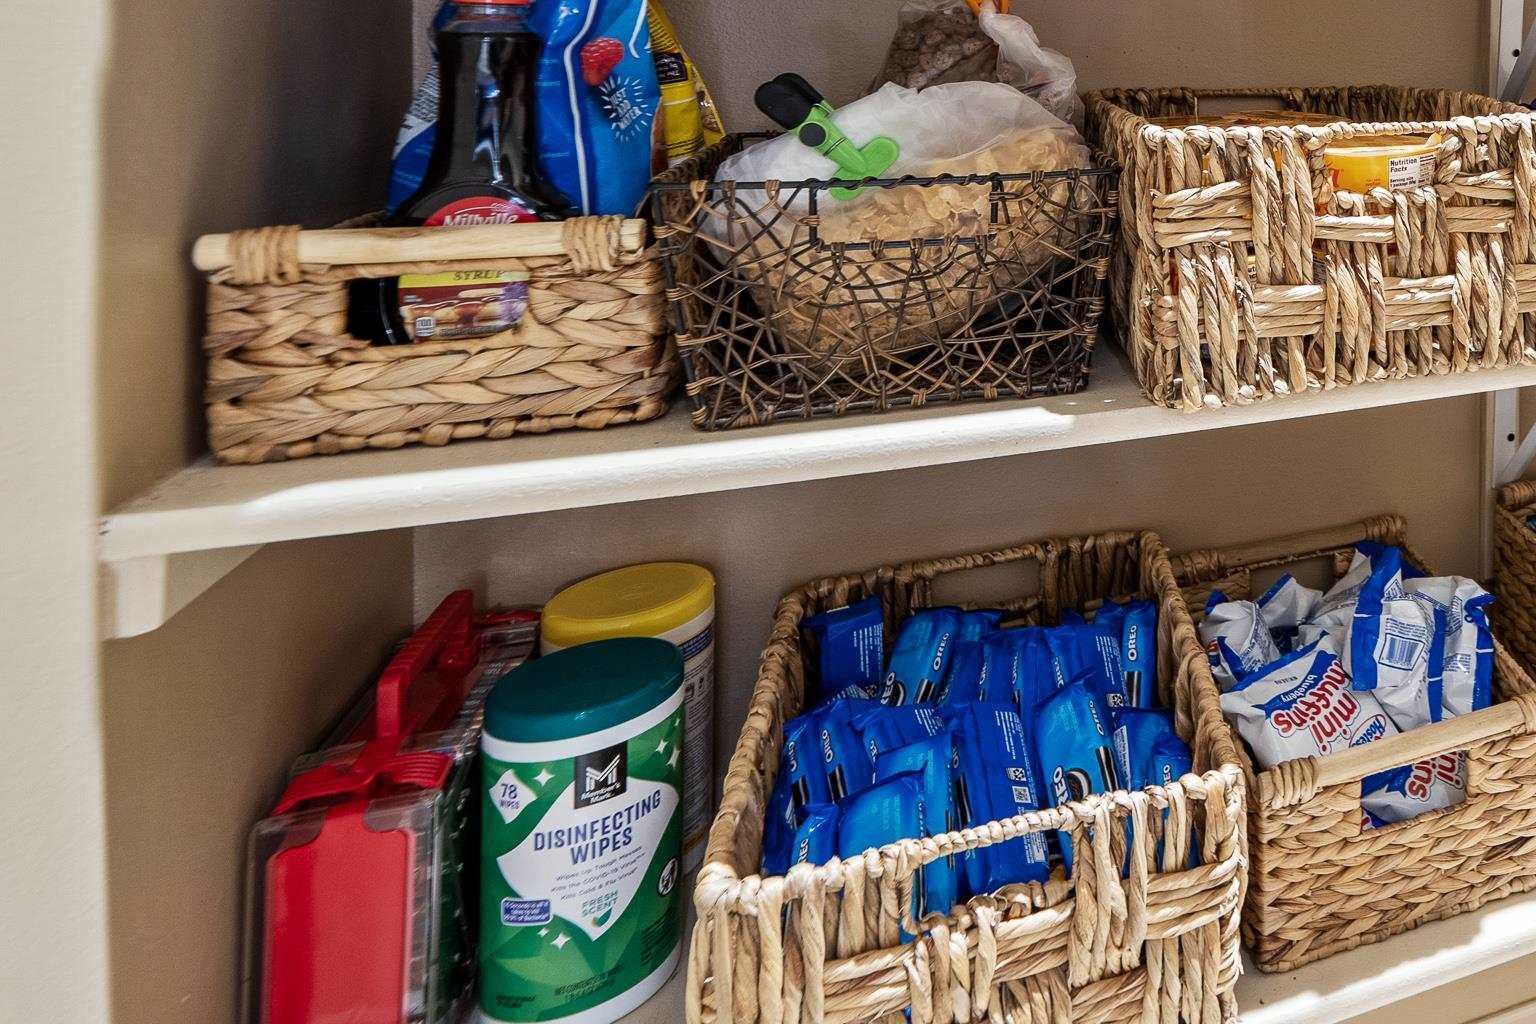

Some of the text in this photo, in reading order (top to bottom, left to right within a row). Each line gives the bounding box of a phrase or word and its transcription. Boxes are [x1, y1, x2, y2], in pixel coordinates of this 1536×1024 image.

[609, 88, 627, 106] JUST
[616, 100, 631, 115] ADD
[618, 107, 642, 128] WATER
[1390, 158, 1418, 166] Nutrition
[933, 632, 950, 671] OREO
[1128, 624, 1138, 661] OREO
[1273, 659, 1347, 734] muffins
[1281, 674, 1318, 703] blueberry
[1311, 692, 1358, 752] mini
[500, 782, 518, 801] 78
[499, 800, 521, 810] WIPES
[533, 788, 662, 852] DISINFECTING
[569, 827, 633, 866] WIPES
[582, 889, 618, 908] FRESH
[582, 896, 619, 917] SCENT
